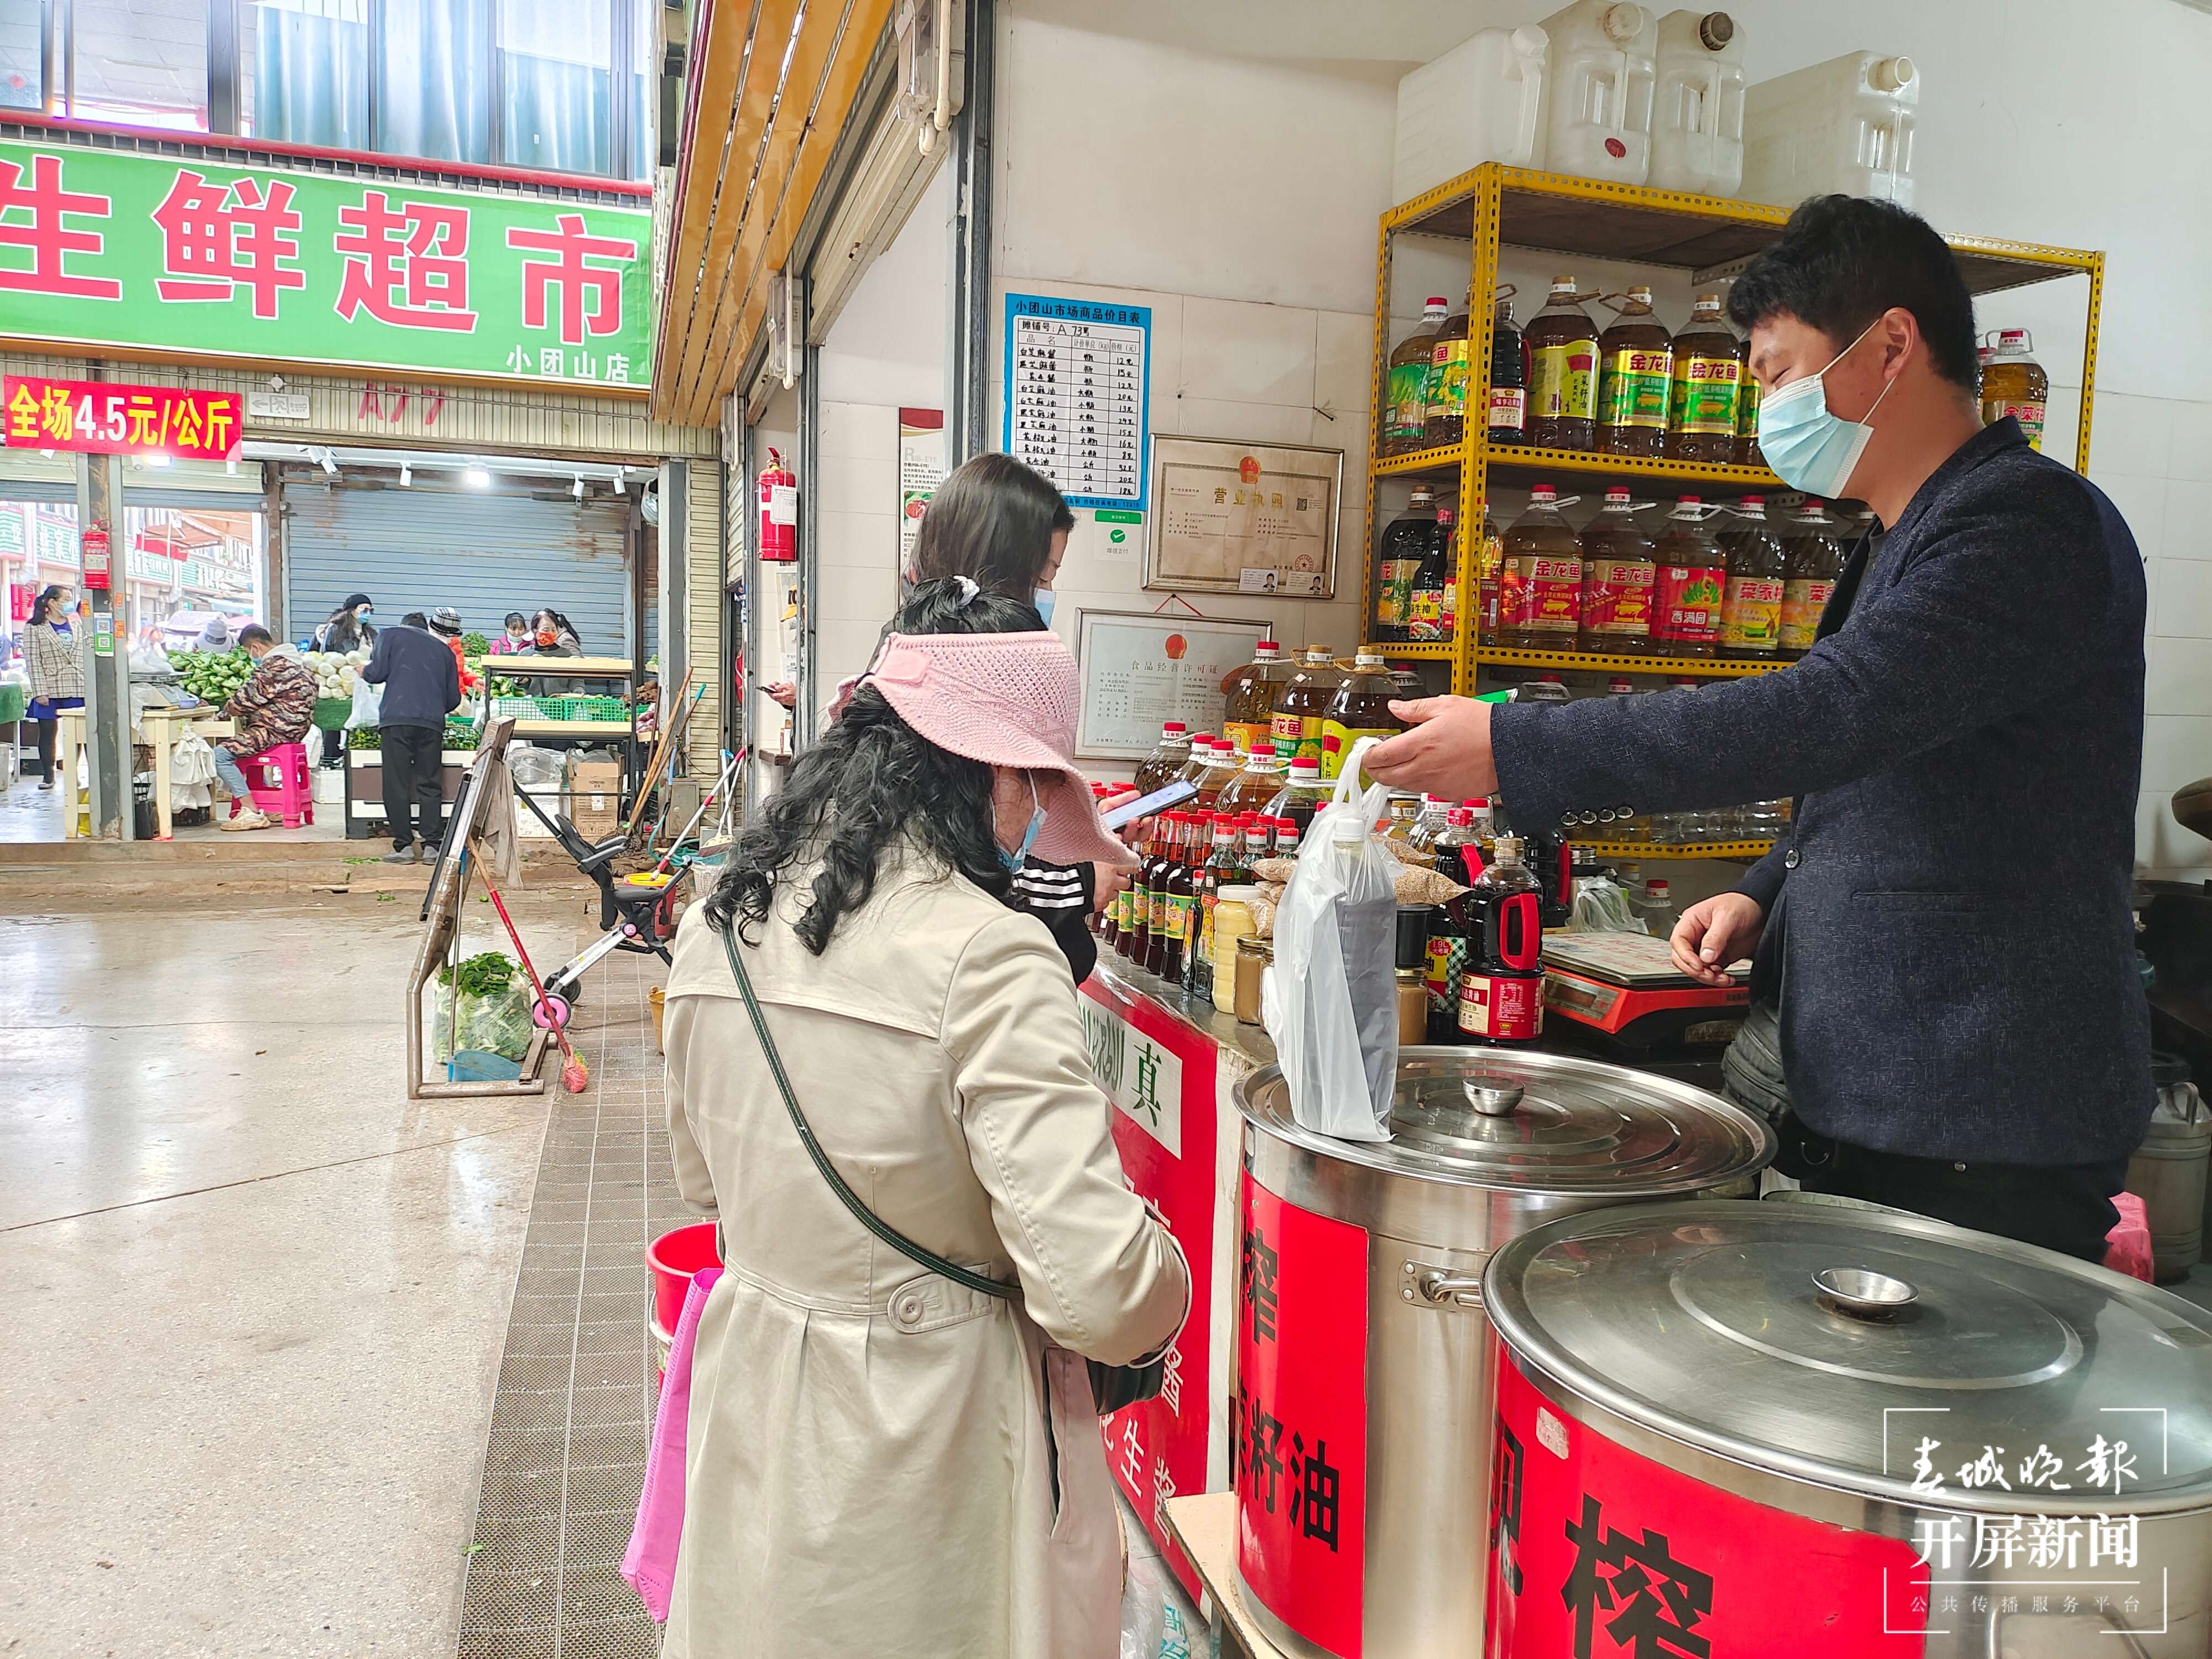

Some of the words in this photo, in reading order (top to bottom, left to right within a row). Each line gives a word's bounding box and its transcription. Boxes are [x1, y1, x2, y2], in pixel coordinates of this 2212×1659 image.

[0, 153, 637, 346] 生鲜超市
[1016, 301, 1140, 324] 小团山市场商品价目表
[1057, 324, 1067, 335] A
[506, 343, 630, 383] 小团山店
[1689, 362, 1738, 381] 金龙鱼
[358, 379, 445, 425] A77
[8, 383, 234, 453] 全场4.5元/公斤
[1214, 487, 1283, 509] 营业执照
[1535, 560, 1581, 579] 金龙鱼
[1610, 566, 1653, 584] 金龙鱼
[1131, 660, 1218, 674] 食品经营许可证
[1271, 717, 1303, 737] 龙鱼
[1131, 1043, 1162, 1128] 真
